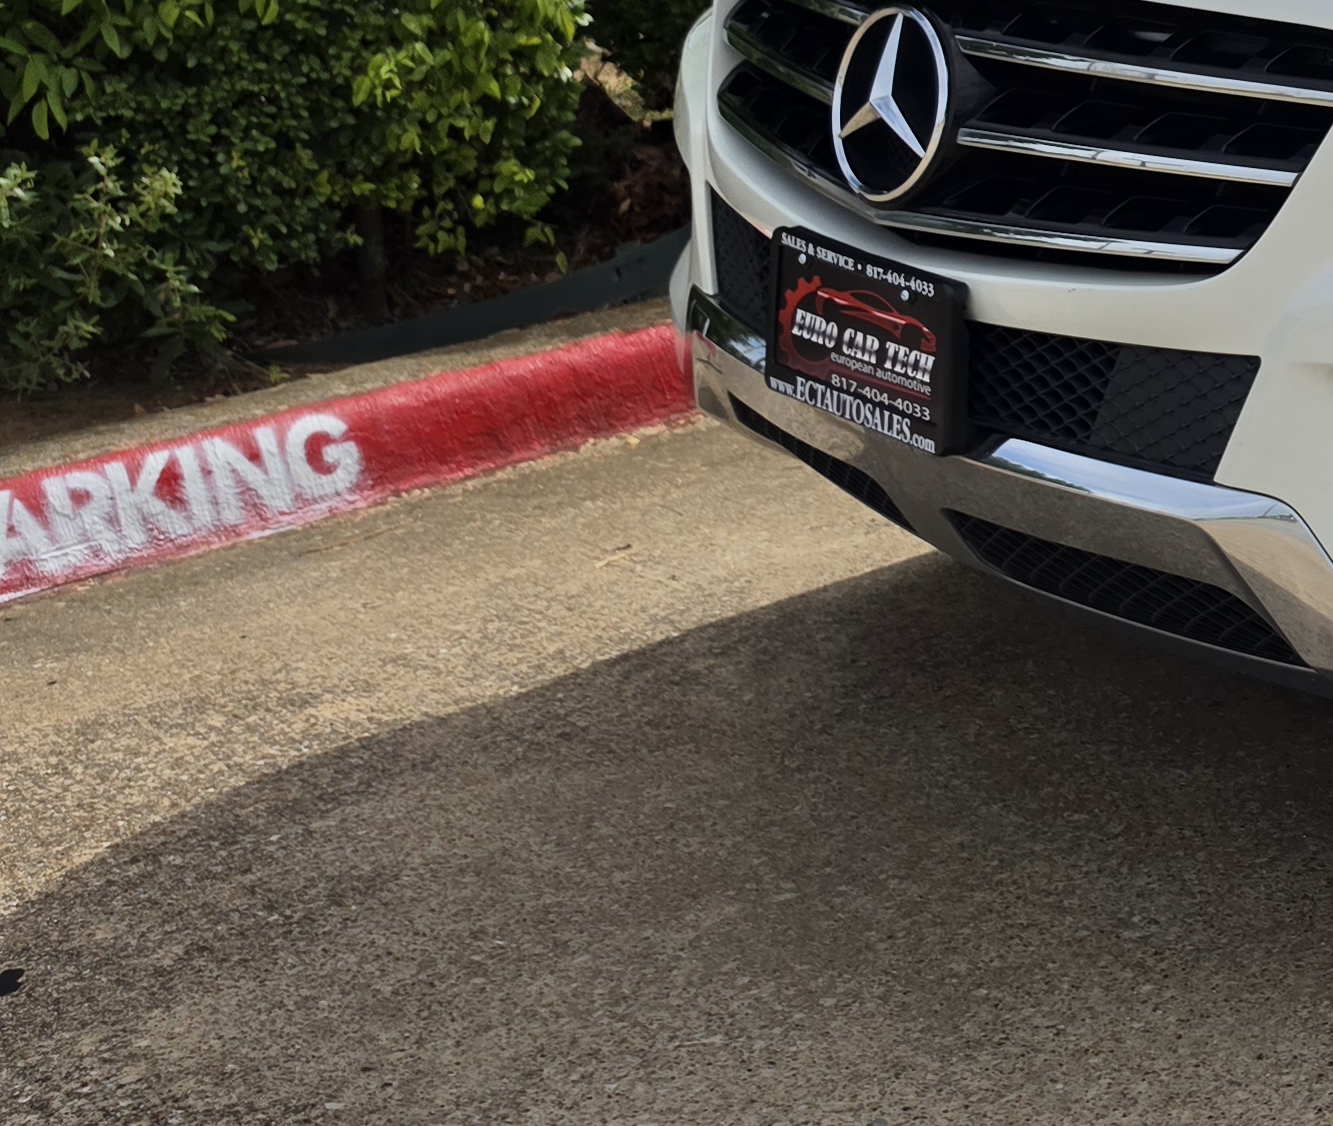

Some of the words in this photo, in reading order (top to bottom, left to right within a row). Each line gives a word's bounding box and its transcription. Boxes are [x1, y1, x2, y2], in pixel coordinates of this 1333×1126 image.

[781, 231, 807, 253] SALES
[808, 243, 815, 256] &
[816, 246, 855, 271] SERVICE
[866, 264, 934, 298] 817-404-4033
[791, 308, 839, 349] EURO
[842, 328, 880, 364] CAR
[884, 341, 936, 383] TECH
[830, 351, 875, 375] european
[876, 368, 932, 396] automotive
[769, 375, 936, 454] www.ECTAUTOSALES.com
[831, 373, 931, 422] 817-404-4033
